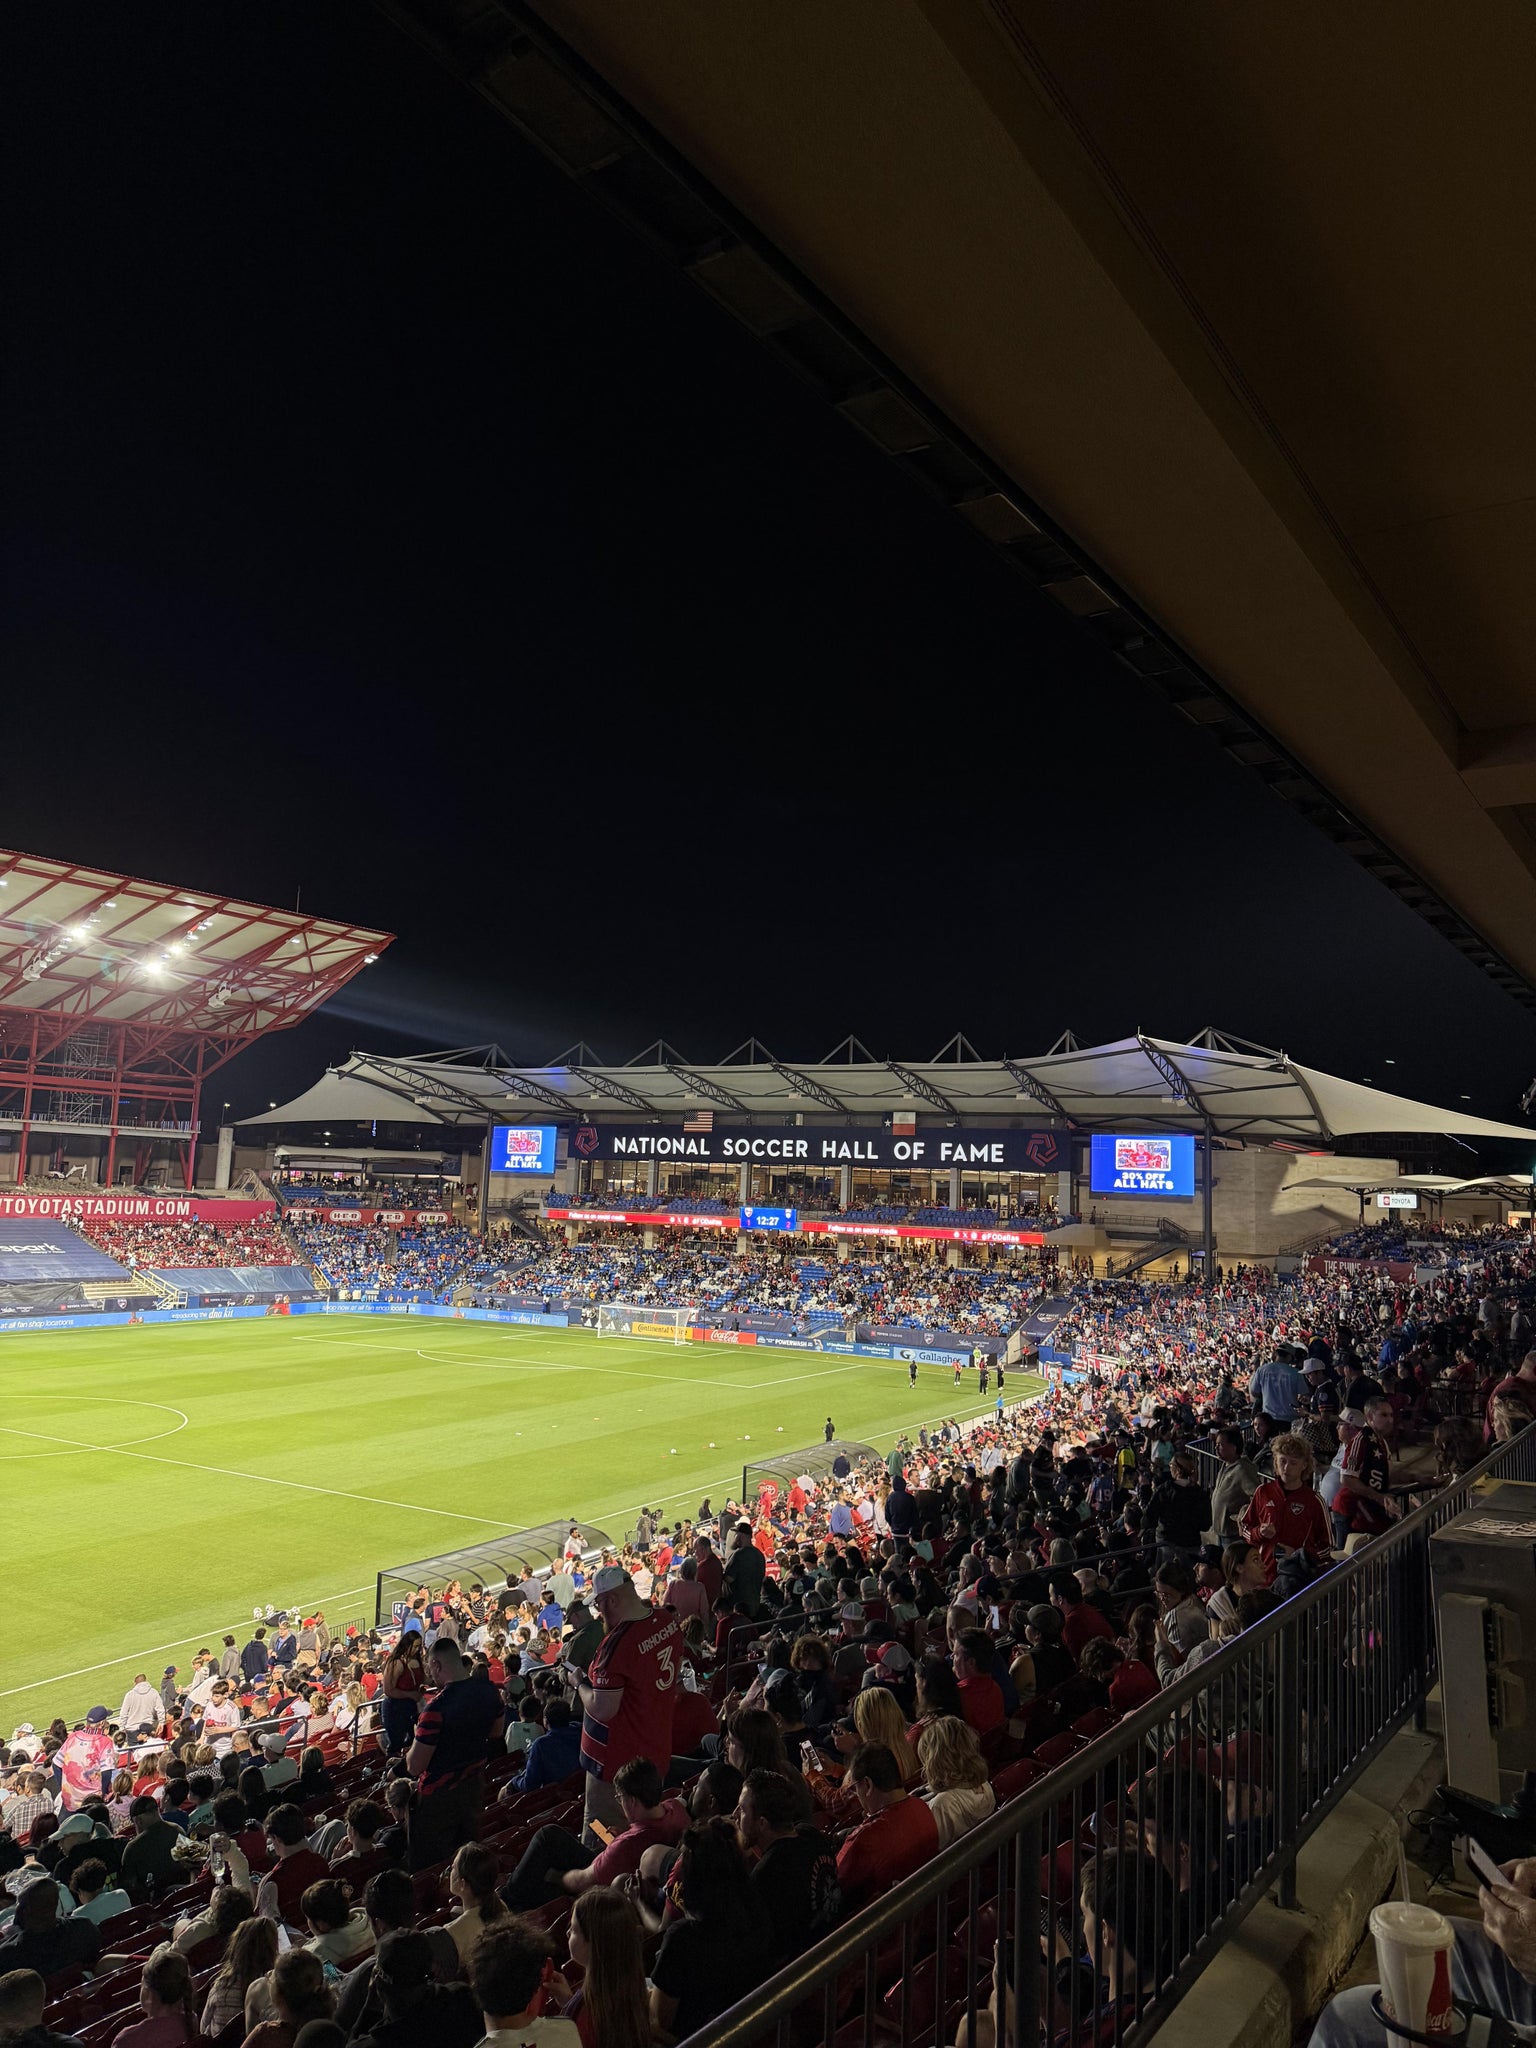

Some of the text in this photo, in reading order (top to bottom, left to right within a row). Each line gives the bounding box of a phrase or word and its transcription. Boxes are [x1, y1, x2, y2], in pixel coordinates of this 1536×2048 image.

[613, 1137, 1004, 1163] NATIONAL SOCCER HALL OF FAME
[505, 1160, 520, 1168] ALL
[1122, 1172, 1165, 1181] 30% OFF
[1114, 1179, 1174, 1190] ALL HATS
[756, 1216, 780, 1226] 12:27
[786, 1221, 791, 1229] 2
[828, 1224, 846, 1232] Follow
[208, 1308, 222, 1319] dna
[223, 1308, 234, 1318] kit
[17, 1320, 28, 1329] fan
[28, 1320, 44, 1329] shop
[45, 1319, 74, 1327] locations
[638, 1323, 669, 1334] Continental
[655, 1645, 675, 1691] 3
